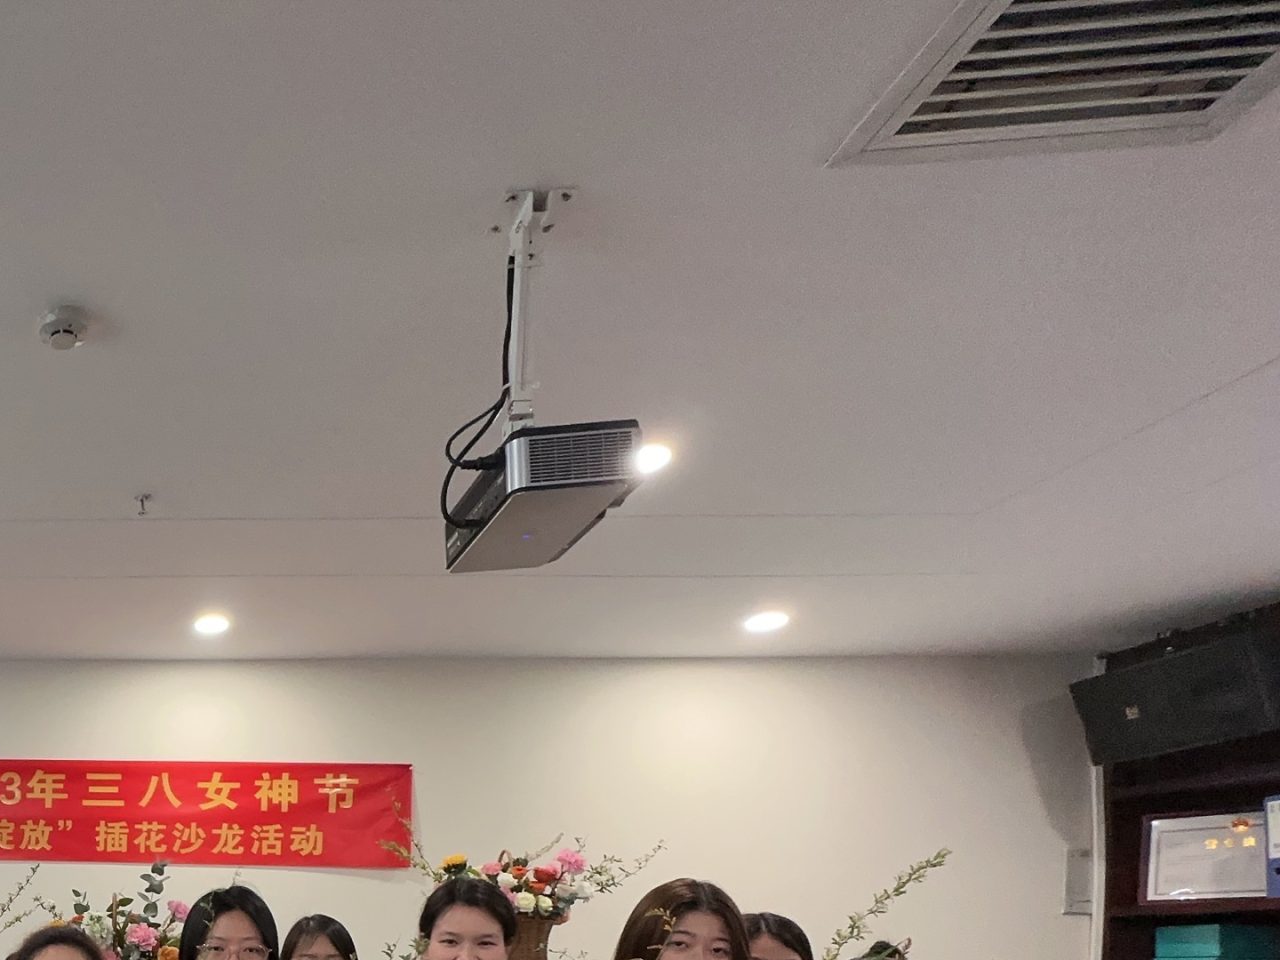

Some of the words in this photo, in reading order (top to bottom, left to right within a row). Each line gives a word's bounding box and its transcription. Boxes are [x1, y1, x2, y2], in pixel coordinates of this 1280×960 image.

[95, 820, 324, 856] 插花沙龙活动
